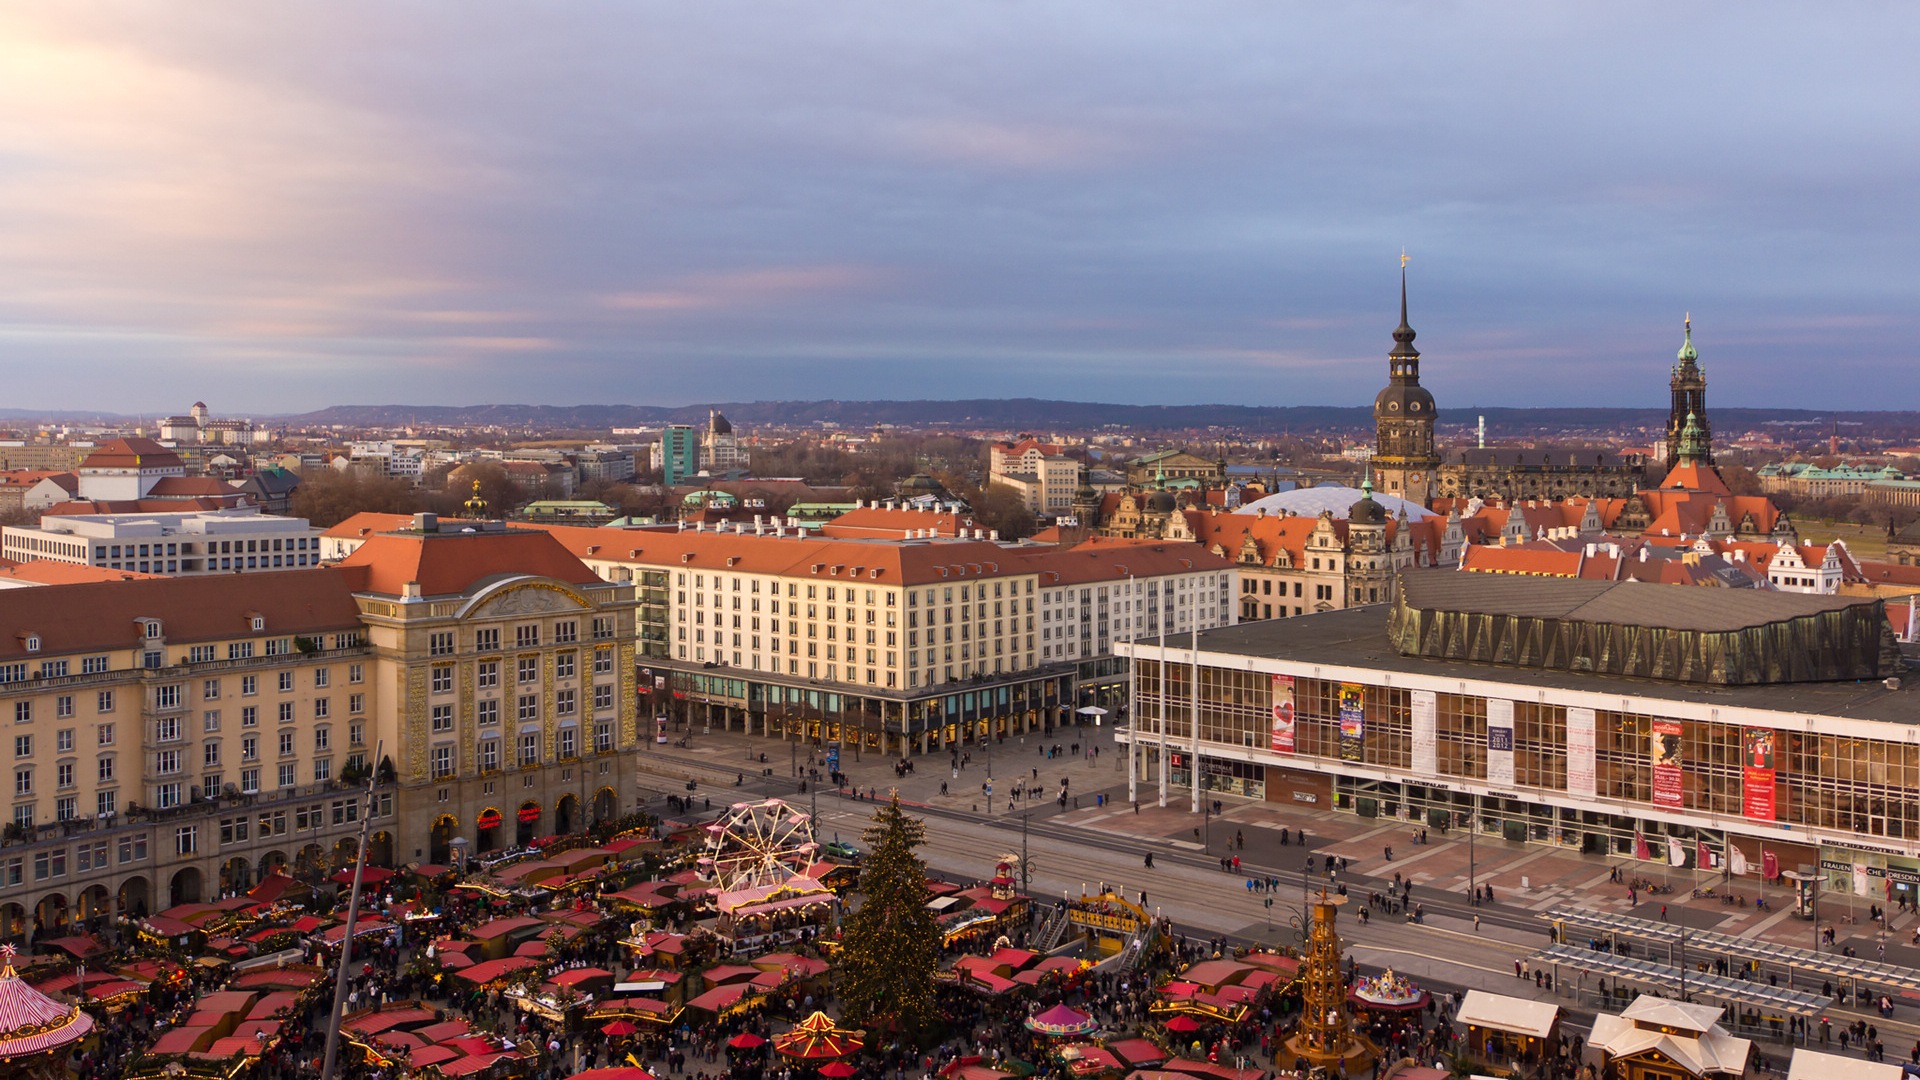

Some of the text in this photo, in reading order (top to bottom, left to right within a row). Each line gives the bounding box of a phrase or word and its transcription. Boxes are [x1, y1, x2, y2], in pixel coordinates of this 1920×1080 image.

[1401, 778, 1449, 789] KULTURPALAST
[1487, 790, 1518, 799] DRESDEN
[1821, 839, 1905, 856] BESUCHERZENTRUM
[1822, 862, 1851, 872] FRAUEN
[1888, 872, 1920, 883] DRESDEN
